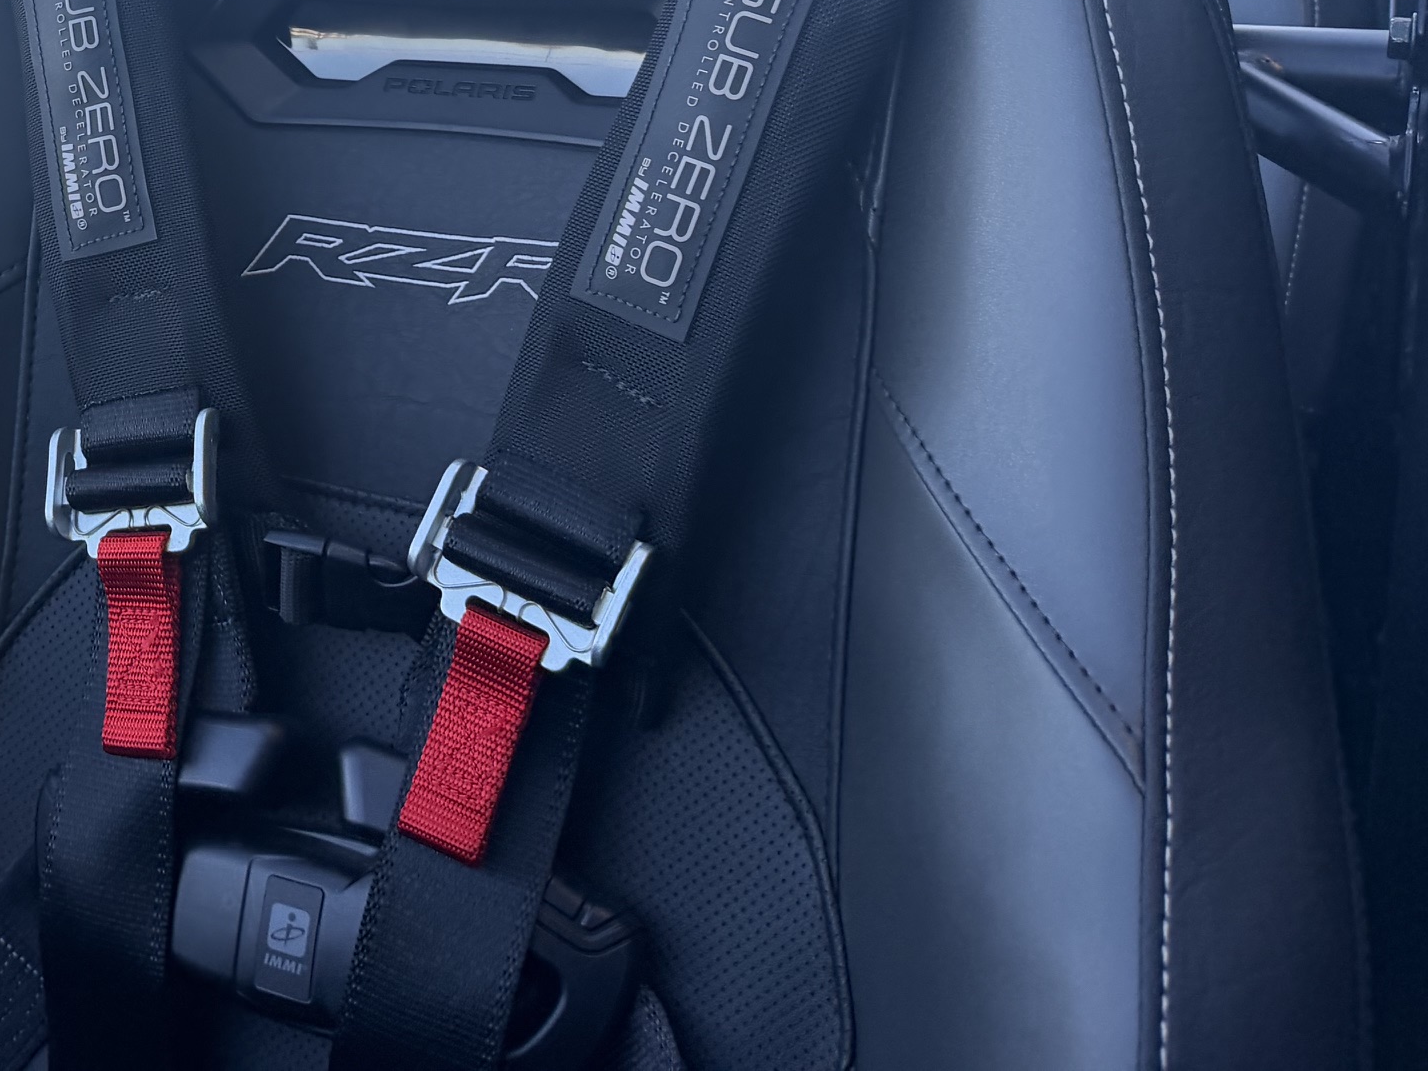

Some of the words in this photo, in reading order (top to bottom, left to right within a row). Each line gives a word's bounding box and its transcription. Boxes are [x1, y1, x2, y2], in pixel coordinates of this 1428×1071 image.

[382, 76, 537, 102] POLARIS
[68, 83, 98, 217] DECELERATOR
[624, 121, 690, 275] DECELERATOR
[264, 952, 302, 975] IMMI
